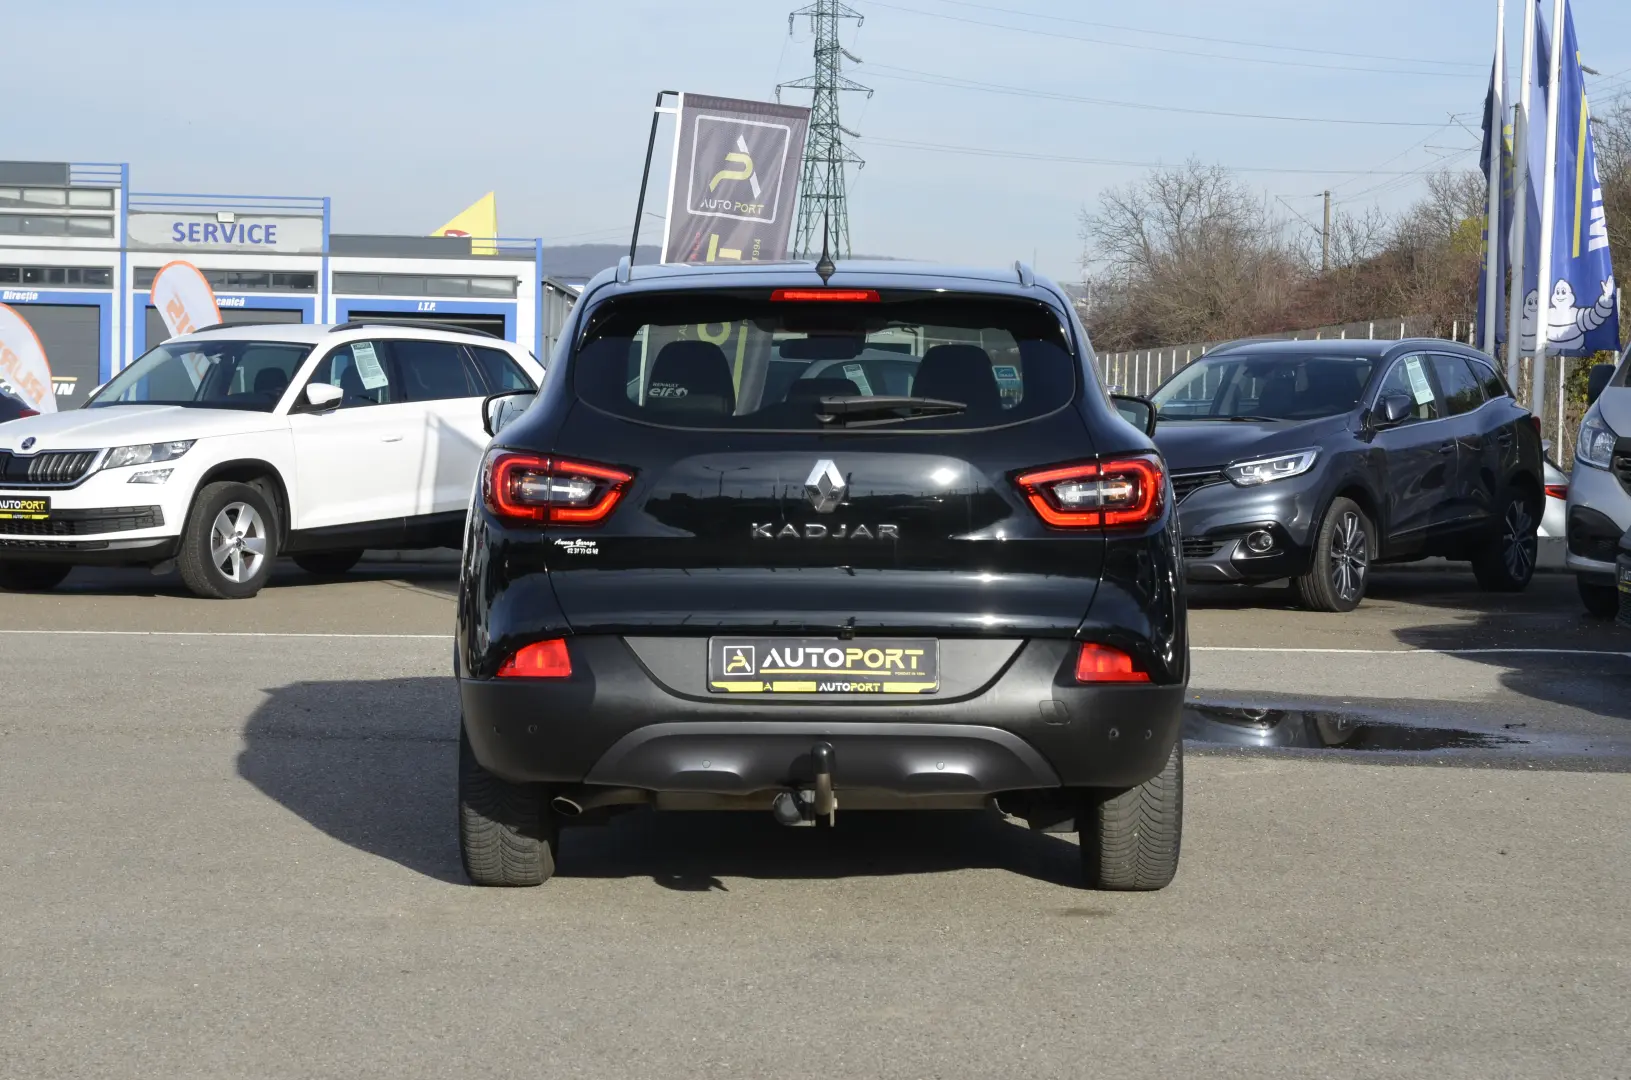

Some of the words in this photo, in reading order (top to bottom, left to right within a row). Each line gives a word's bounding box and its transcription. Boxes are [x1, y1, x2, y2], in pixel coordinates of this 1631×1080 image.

[700, 198, 731, 210] AUTO
[734, 202, 764, 214] PORT
[172, 222, 277, 244] SERVICE
[649, 387, 674, 397] elf
[751, 522, 899, 539] KADJAR
[762, 647, 924, 669] AUTOPORT
[818, 682, 881, 692] AUTOPORT
